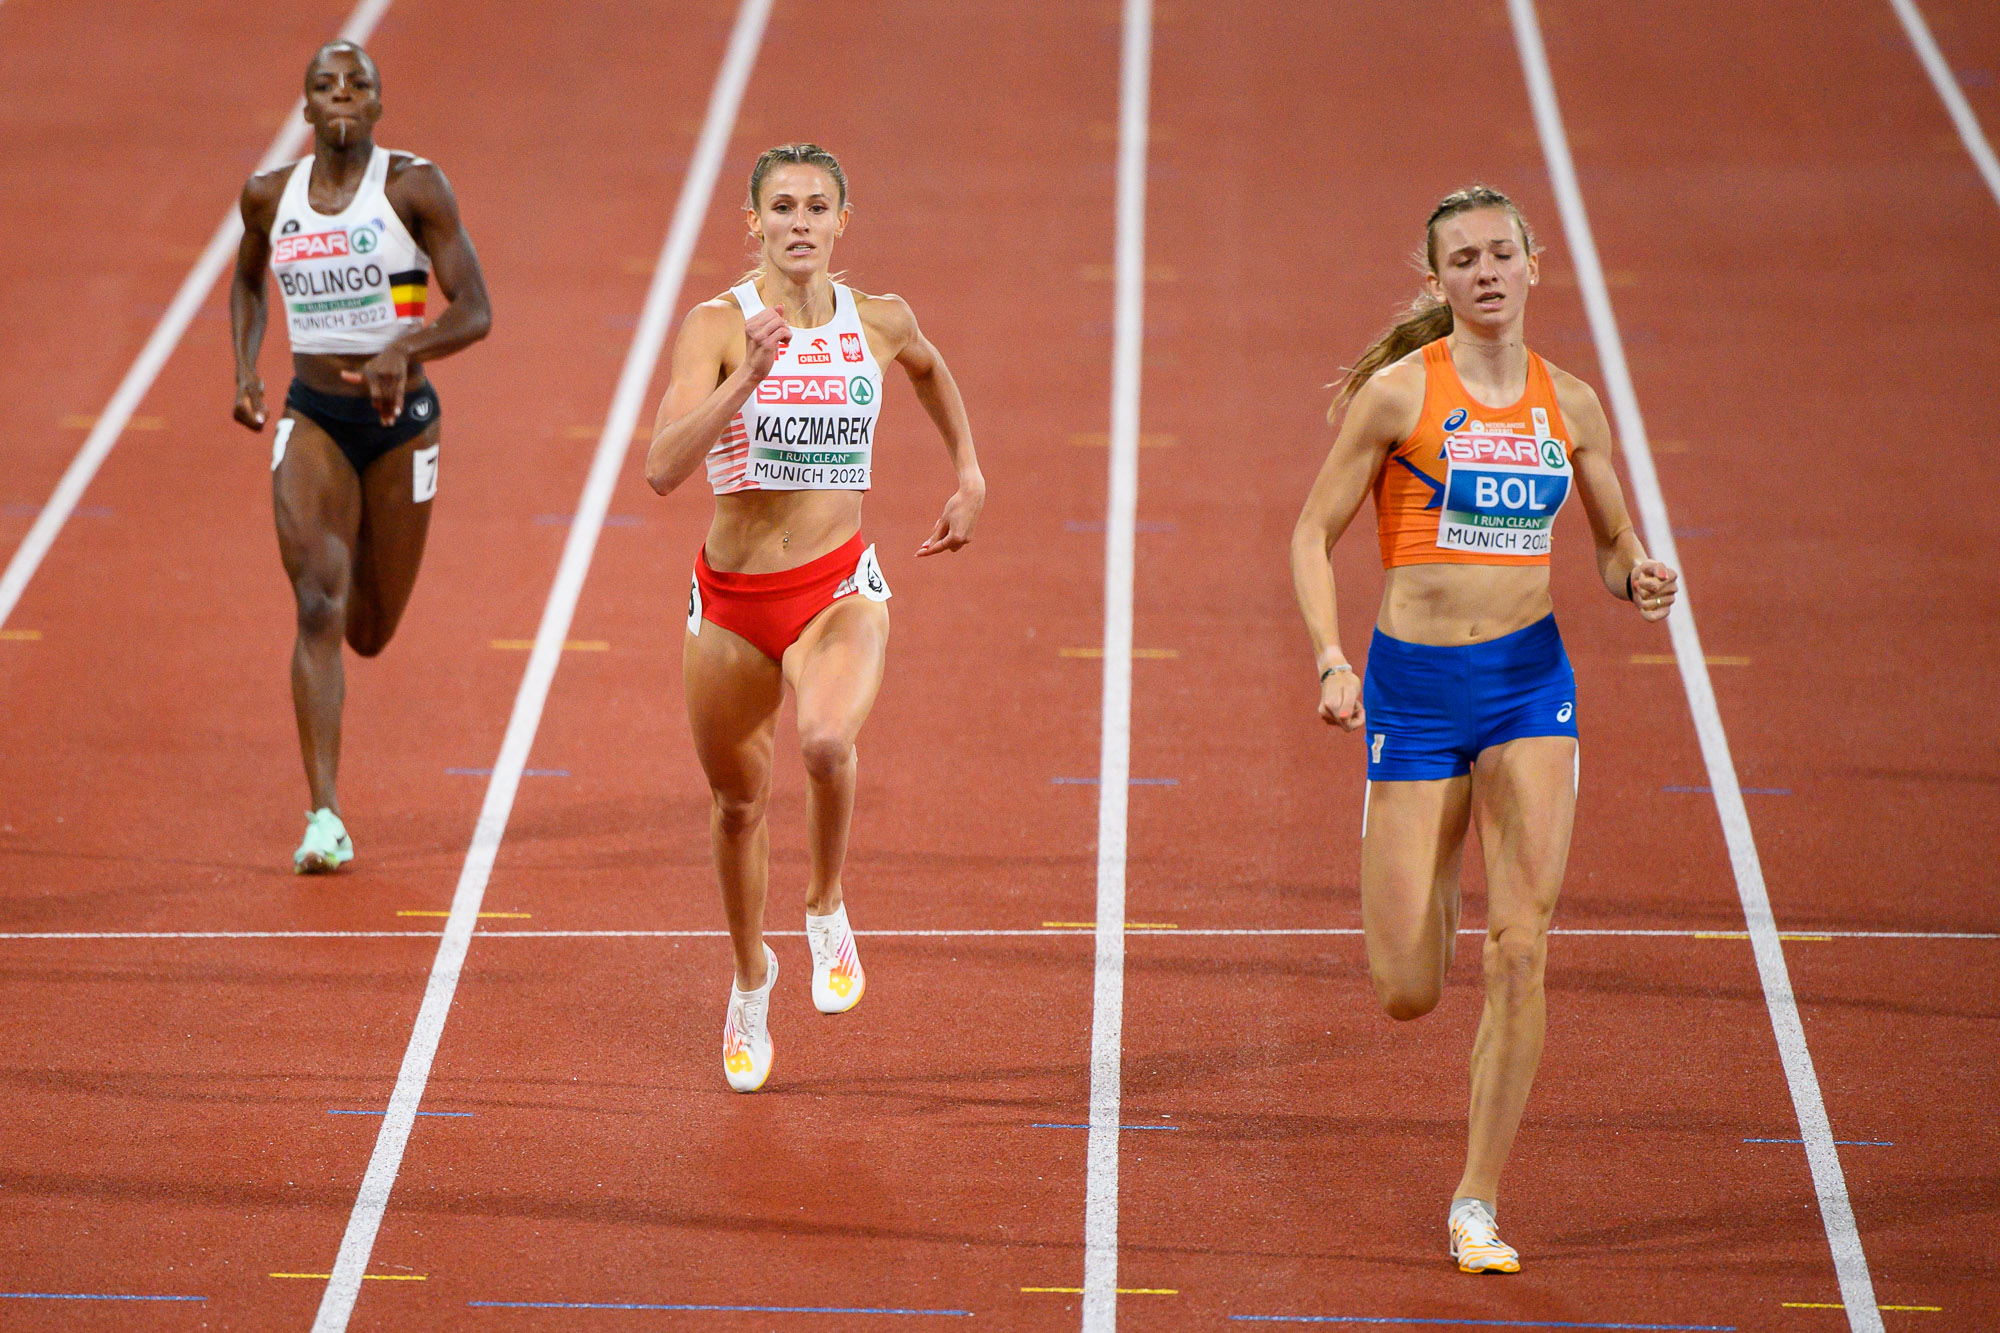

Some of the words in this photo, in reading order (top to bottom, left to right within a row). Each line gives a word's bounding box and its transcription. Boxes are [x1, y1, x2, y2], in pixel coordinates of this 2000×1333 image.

[277, 234, 348, 260] SPAR
[280, 264, 382, 296] BOLINGO
[293, 313, 345, 330] MUNICH
[350, 306, 388, 327] 2022
[799, 355, 829, 363] ORLEN
[759, 379, 846, 401] SPAR
[755, 415, 873, 445] KACZMAREK
[785, 452, 811, 462] RUN
[1453, 439, 1537, 462] SPAR
[427, 456, 437, 491] 7
[754, 463, 823, 483] MUNICH
[829, 468, 865, 484] 2022
[1476, 476, 1547, 511] BOL
[1481, 516, 1505, 527] RUN
[1447, 527, 1517, 548] MUNICH
